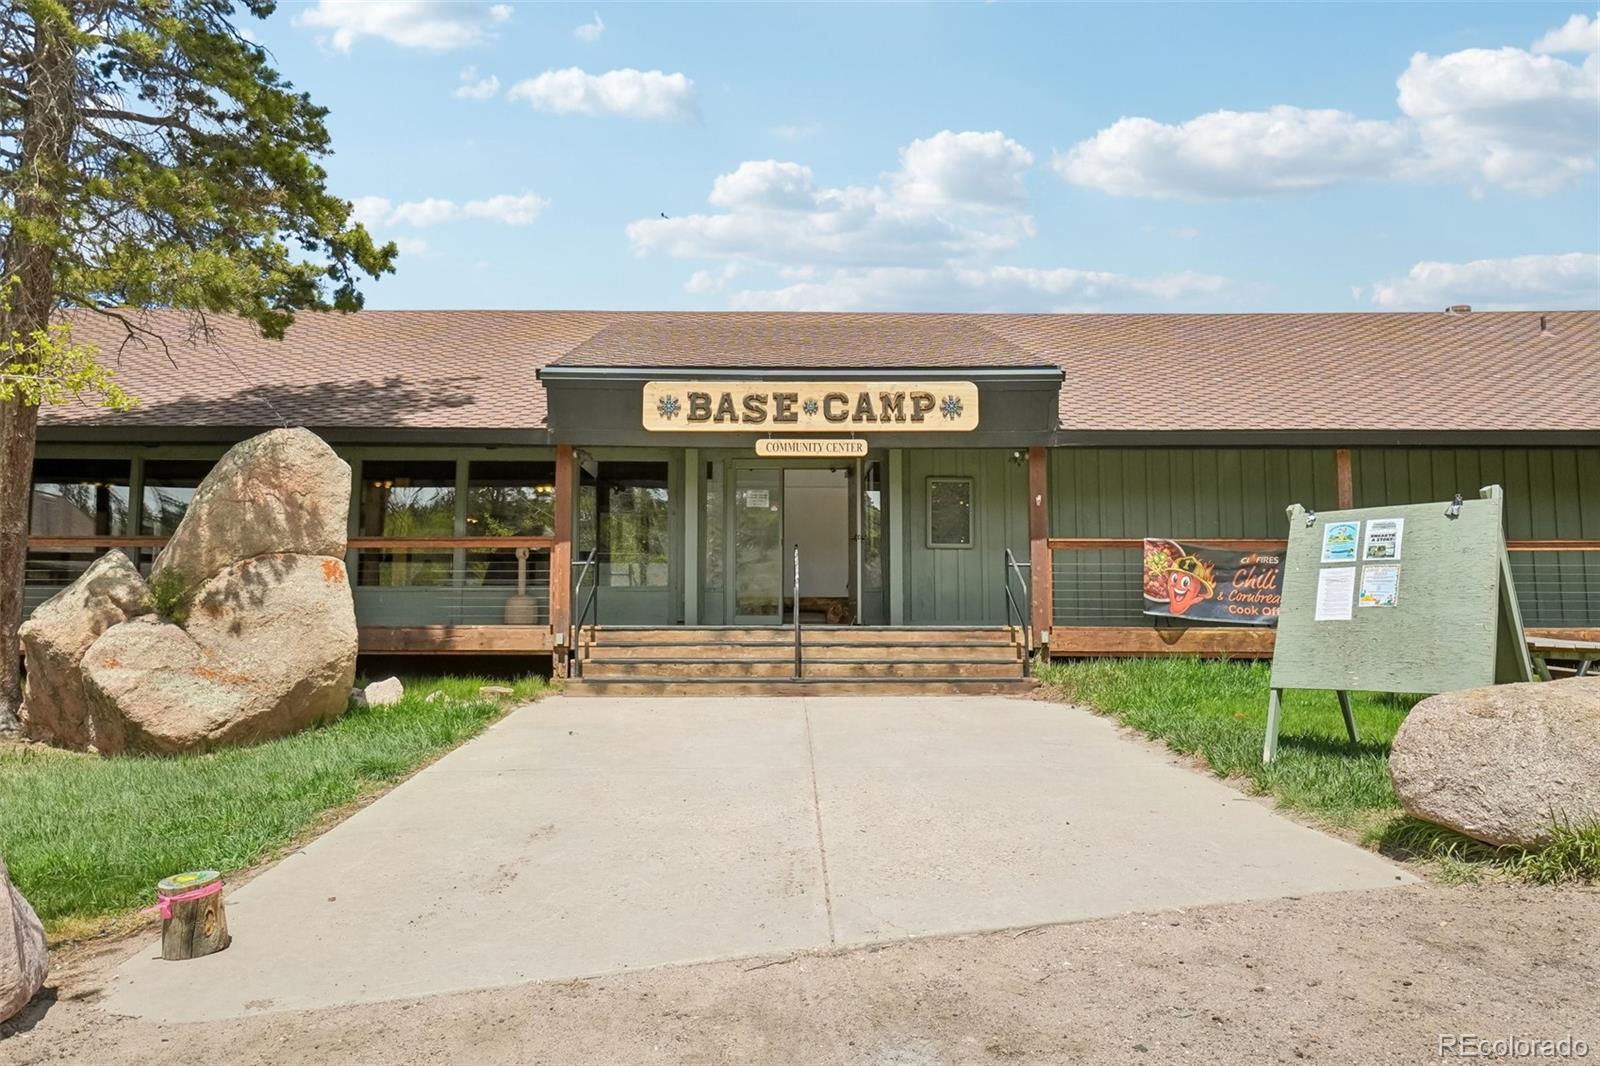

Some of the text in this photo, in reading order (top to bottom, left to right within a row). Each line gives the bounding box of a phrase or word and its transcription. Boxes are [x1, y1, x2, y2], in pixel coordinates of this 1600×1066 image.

[687, 392, 936, 424] BASE CAMP
[766, 442, 863, 453] COMMUNITY CENTER
[1232, 566, 1279, 589] Chili
[1217, 589, 1280, 604] & Cornbrea
[1228, 604, 1281, 616] Cook Off
